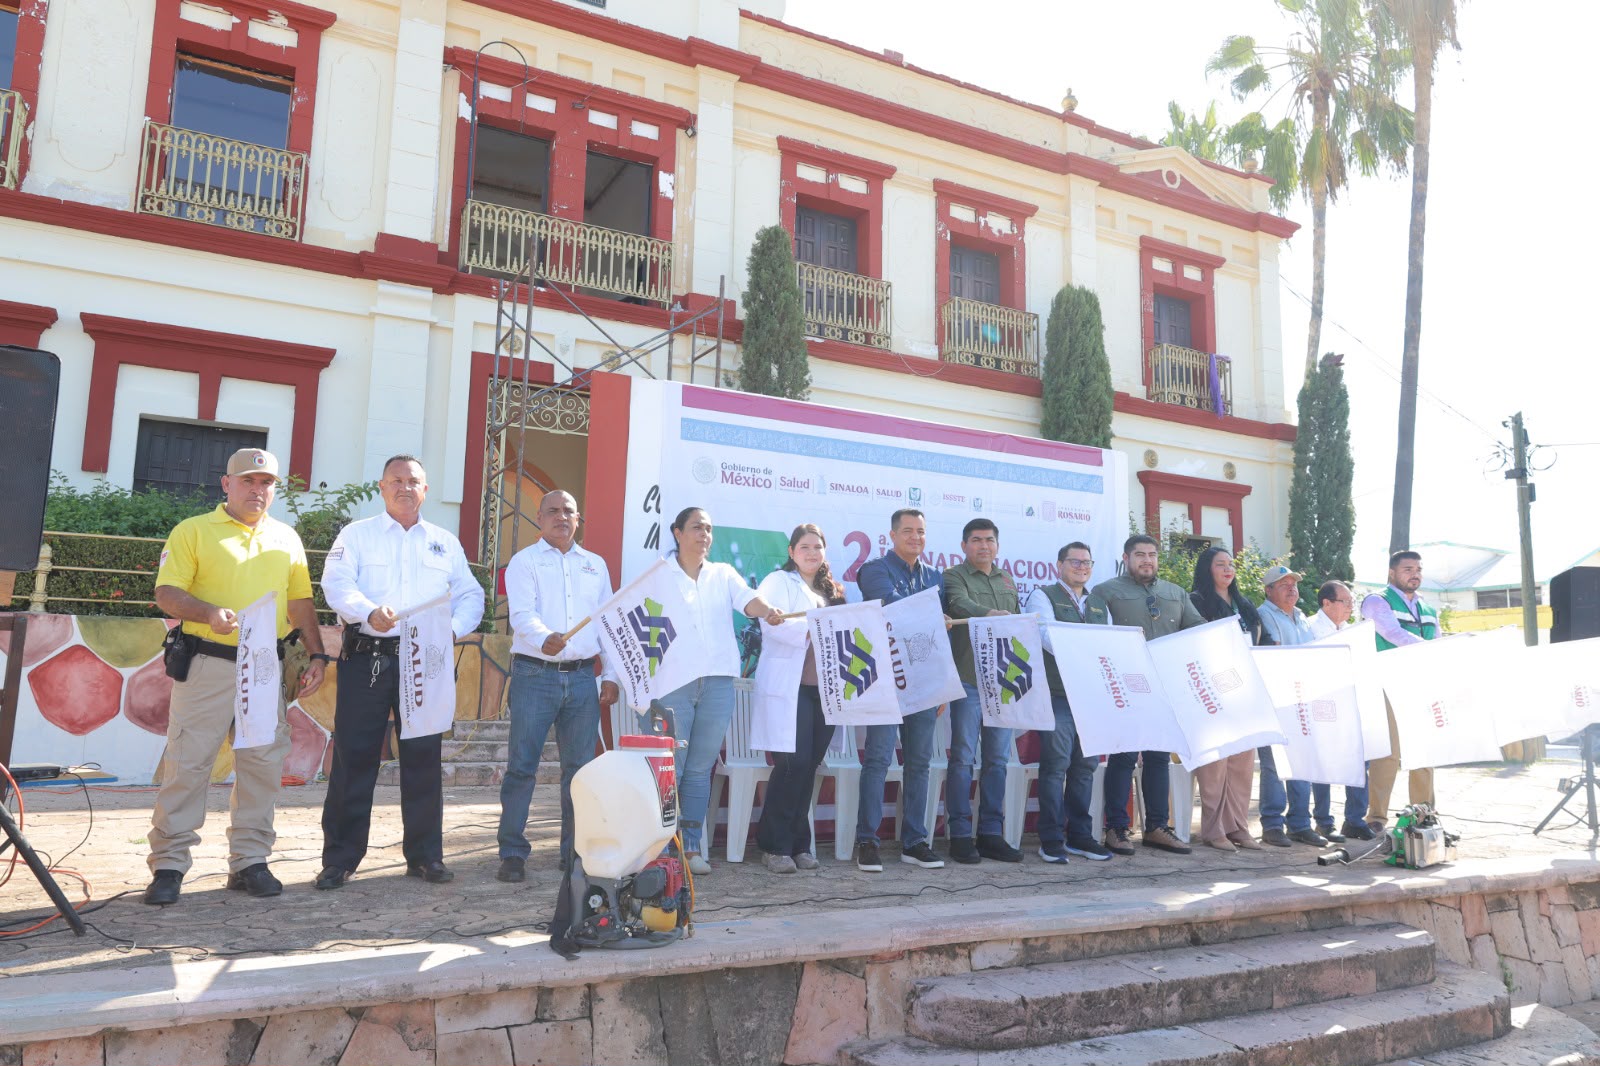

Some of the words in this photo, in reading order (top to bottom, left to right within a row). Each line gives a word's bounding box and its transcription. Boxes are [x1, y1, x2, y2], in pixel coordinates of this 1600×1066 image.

[721, 462, 761, 474] Gobierno
[763, 467, 773, 475] de
[721, 470, 772, 489] México
[779, 476, 810, 489] Salud
[829, 482, 869, 495] SINALOA
[876, 488, 902, 498] SALUD
[943, 493, 966, 503] ISSSTE
[1057, 510, 1091, 521] ROSARIO
[410, 625, 423, 708] SALUD
[616, 607, 638, 651] SERVICIOS
[635, 651, 644, 663] DE
[640, 664, 650, 694] SALUD
[616, 626, 642, 684] SINALOA
[824, 636, 834, 696] SINALOA
[886, 621, 907, 691] SALUD
[980, 642, 994, 699] SINALOA
[986, 627, 995, 672] SERVICIOS
[834, 682, 842, 712] SALUD
[1098, 656, 1125, 709] ROSARIO
[1186, 662, 1218, 715] ROSARIO
